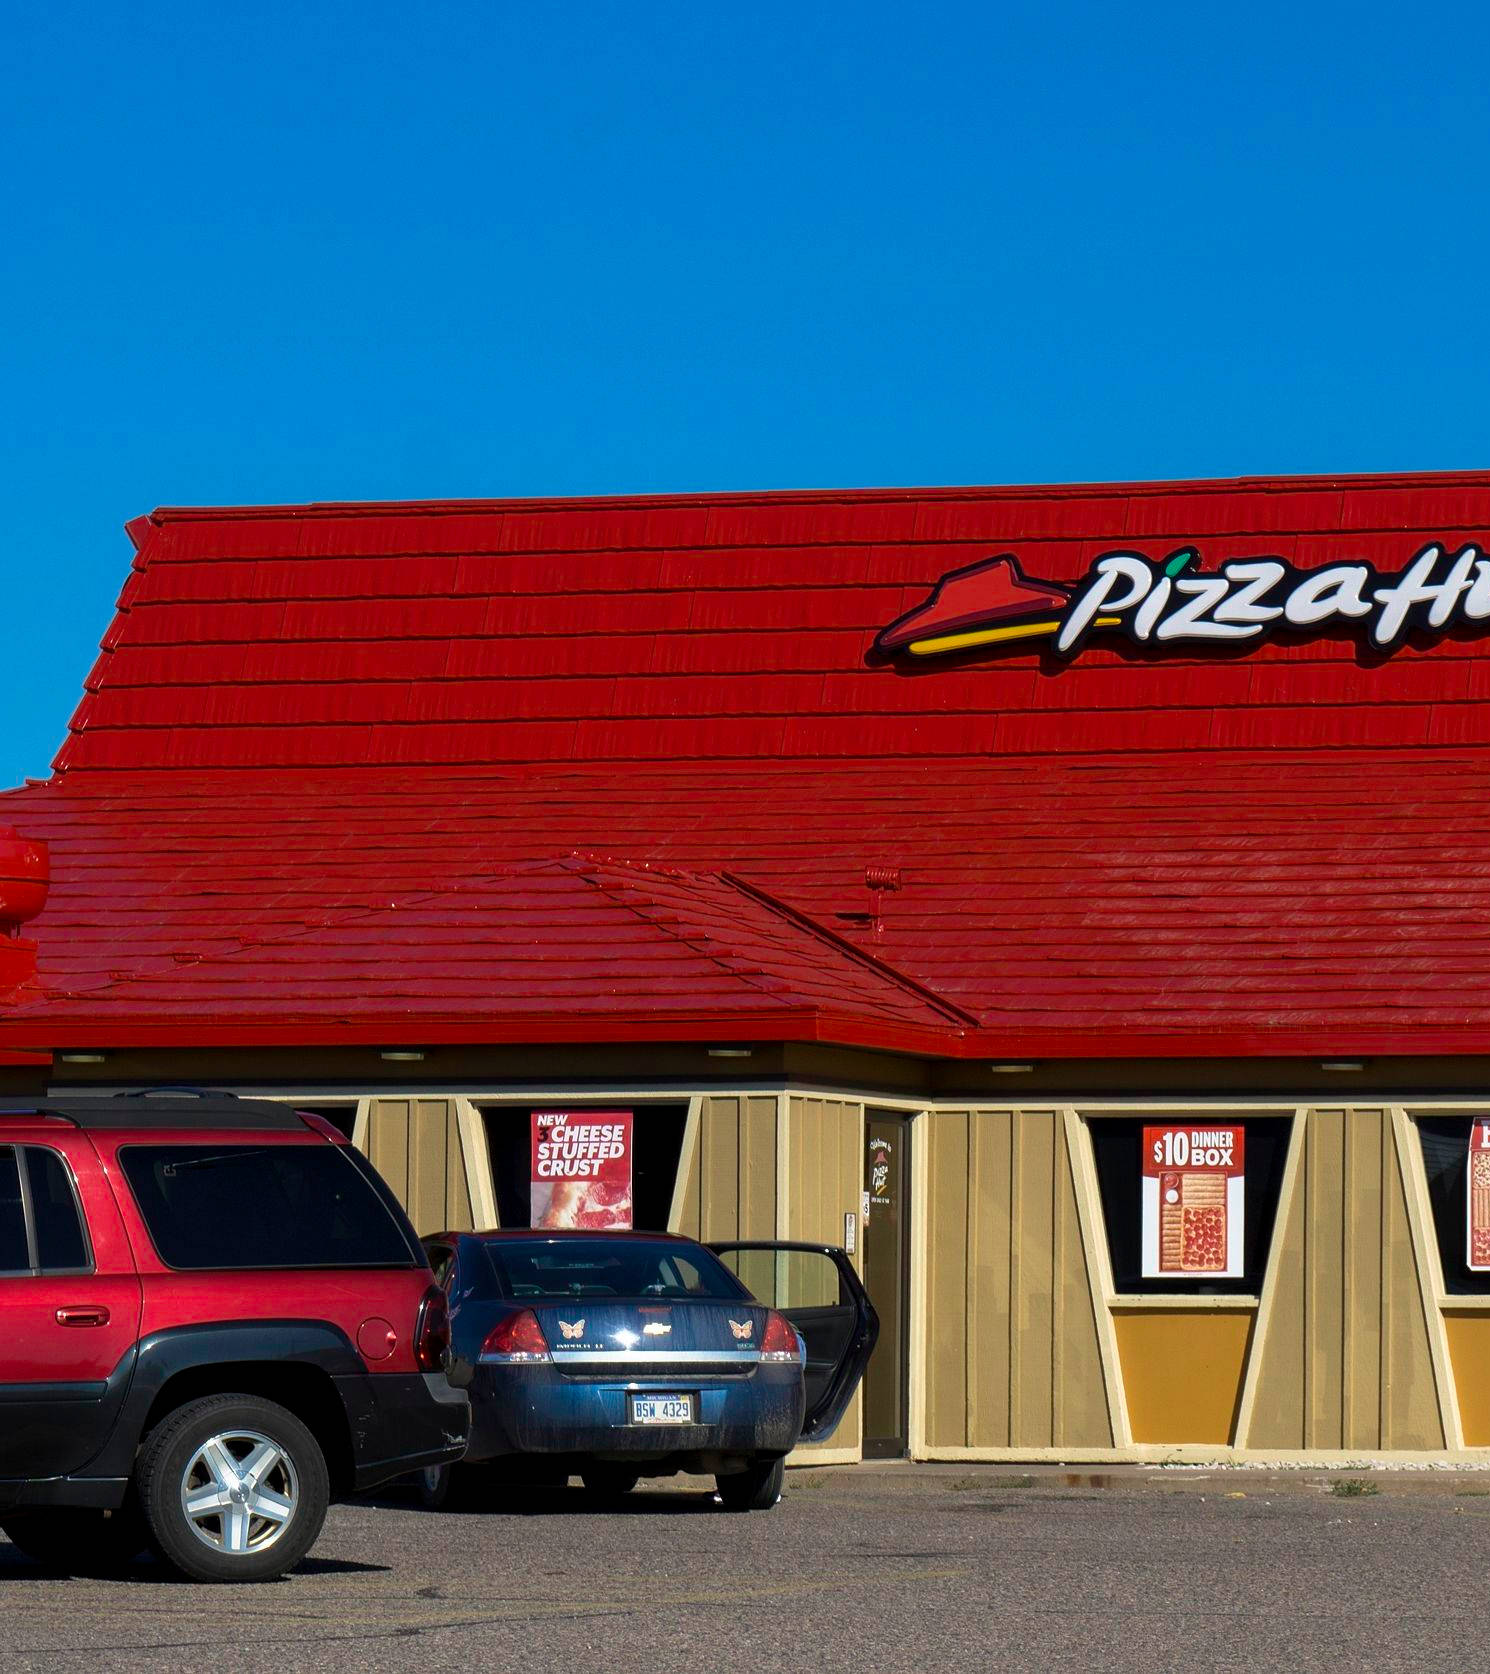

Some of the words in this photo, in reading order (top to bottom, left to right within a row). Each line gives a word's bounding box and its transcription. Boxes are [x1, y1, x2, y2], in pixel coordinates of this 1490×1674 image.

[1057, 552, 1373, 652] Pizza
[537, 1115, 568, 1126] NEW
[537, 1126, 549, 1142] 3
[551, 1125, 625, 1142] CHEESE
[537, 1142, 625, 1159] STUFFED
[1154, 1132, 1189, 1166] $10
[1191, 1132, 1234, 1147] DINNER
[1191, 1149, 1234, 1166] BOX
[537, 1159, 604, 1176] CRUST
[636, 1402, 656, 1417] BSW
[662, 1402, 689, 1417] 4329
